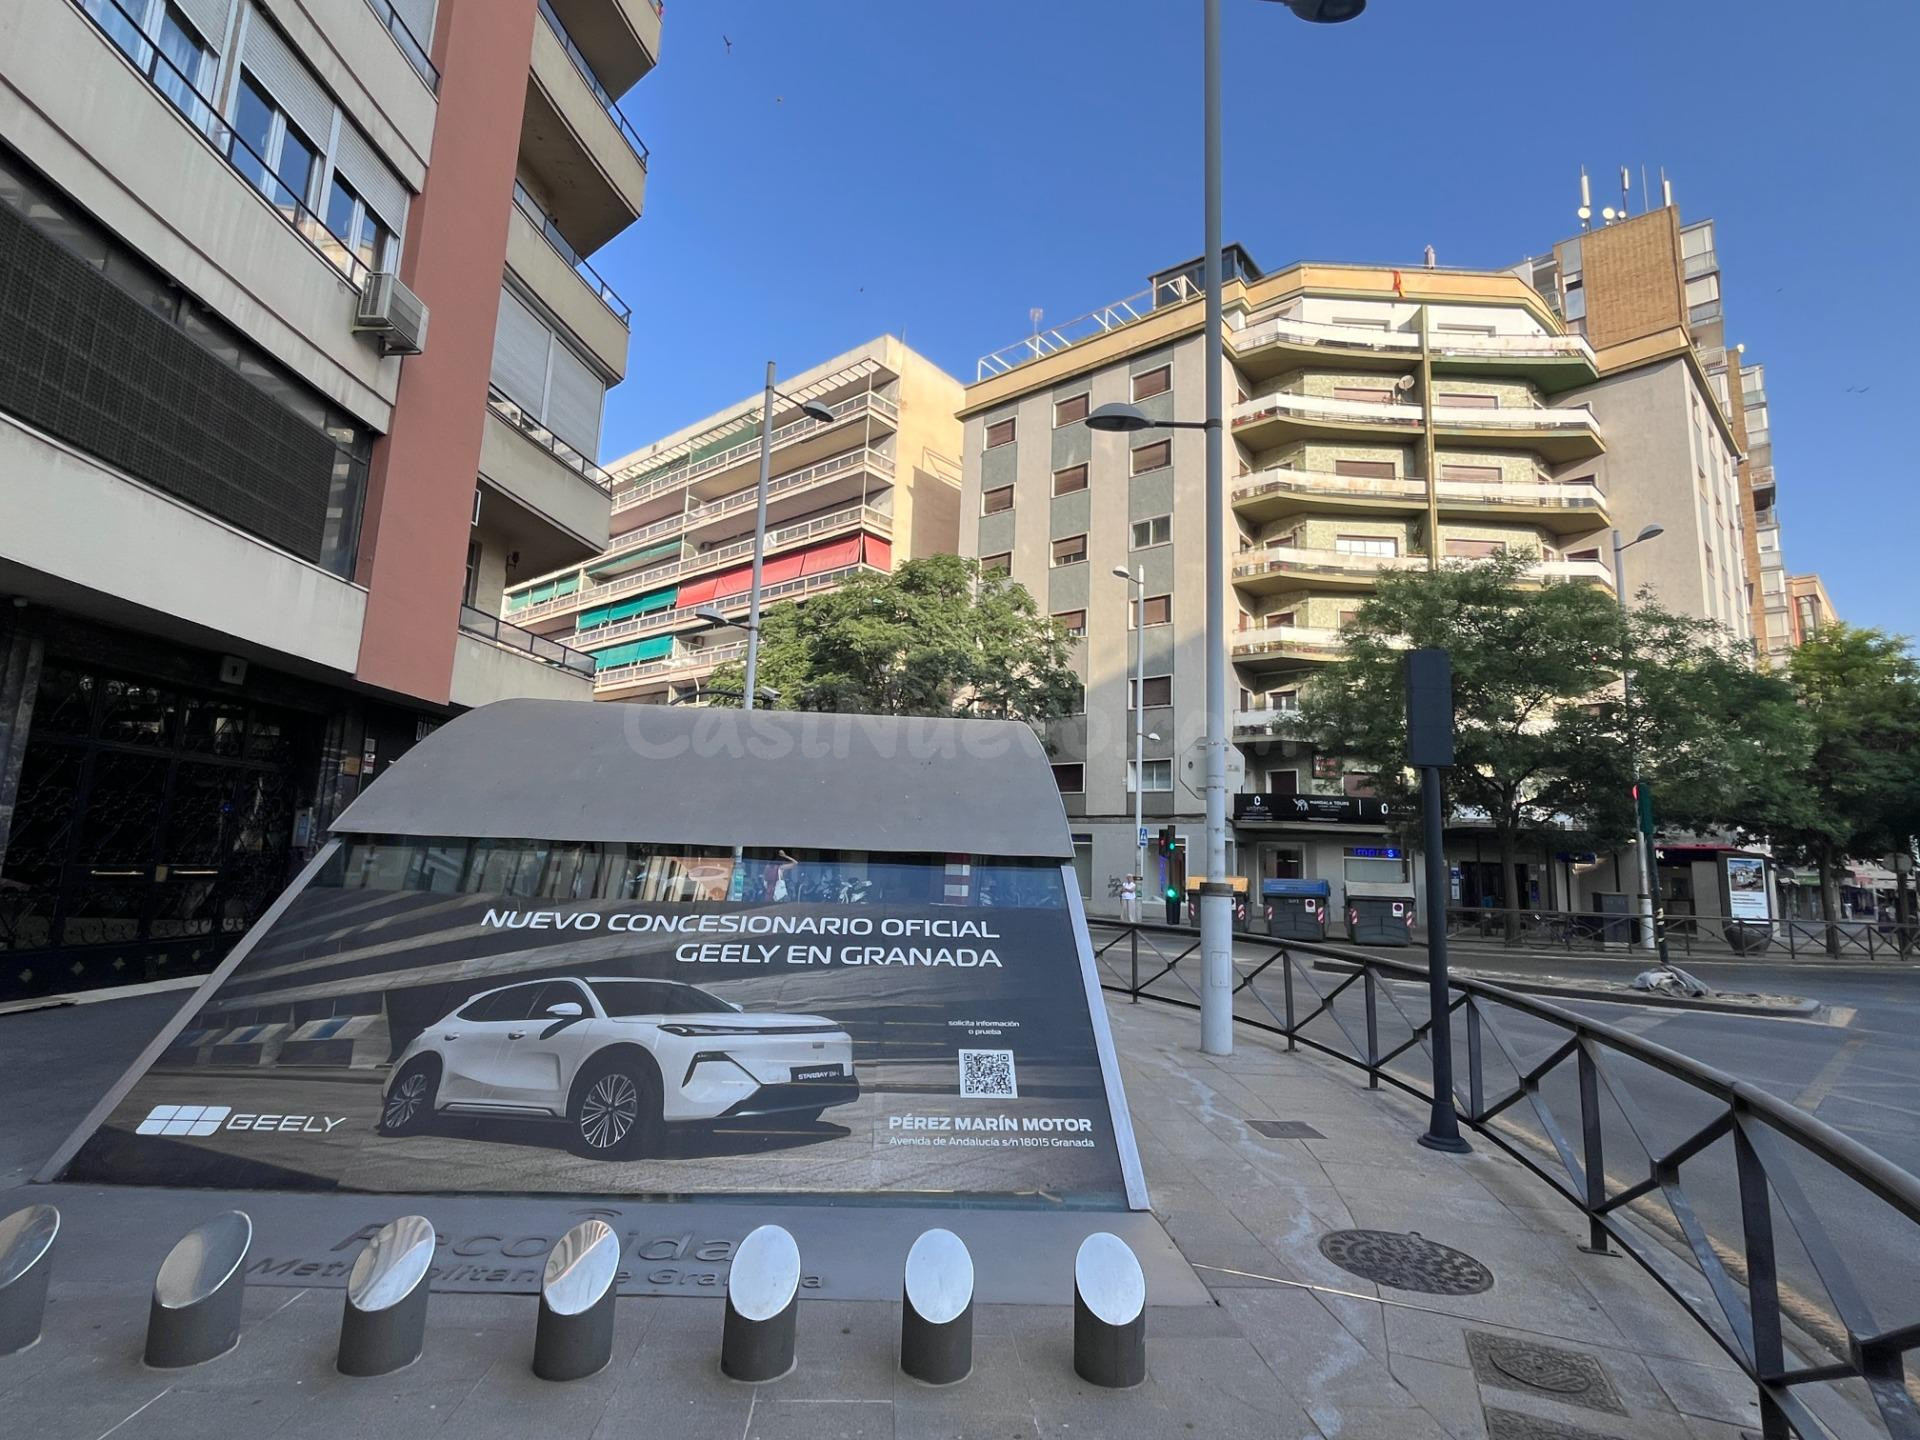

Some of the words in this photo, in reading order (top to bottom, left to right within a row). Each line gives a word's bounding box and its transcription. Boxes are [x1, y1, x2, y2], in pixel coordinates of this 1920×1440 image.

[480, 908, 600, 931] NUEVO
[607, 913, 873, 937] CONCESIONARIO
[881, 918, 1001, 939] OFICIAL
[675, 943, 781, 964] GEELY
[786, 945, 831, 965] EN
[841, 946, 1003, 968] GRANADA
[226, 1114, 347, 1133] GEELY
[888, 1113, 951, 1130] PÉREZ
[954, 1115, 1018, 1131] MARÍN
[1022, 1118, 1093, 1132] MOTOR
[888, 1136, 930, 1146] Avenida
[933, 1136, 947, 1146] de
[949, 1137, 1000, 1147] Andalucía
[1002, 1137, 1019, 1147] s/n
[1020, 1138, 1050, 1147] 18015
[1051, 1138, 1095, 1148] Granada
